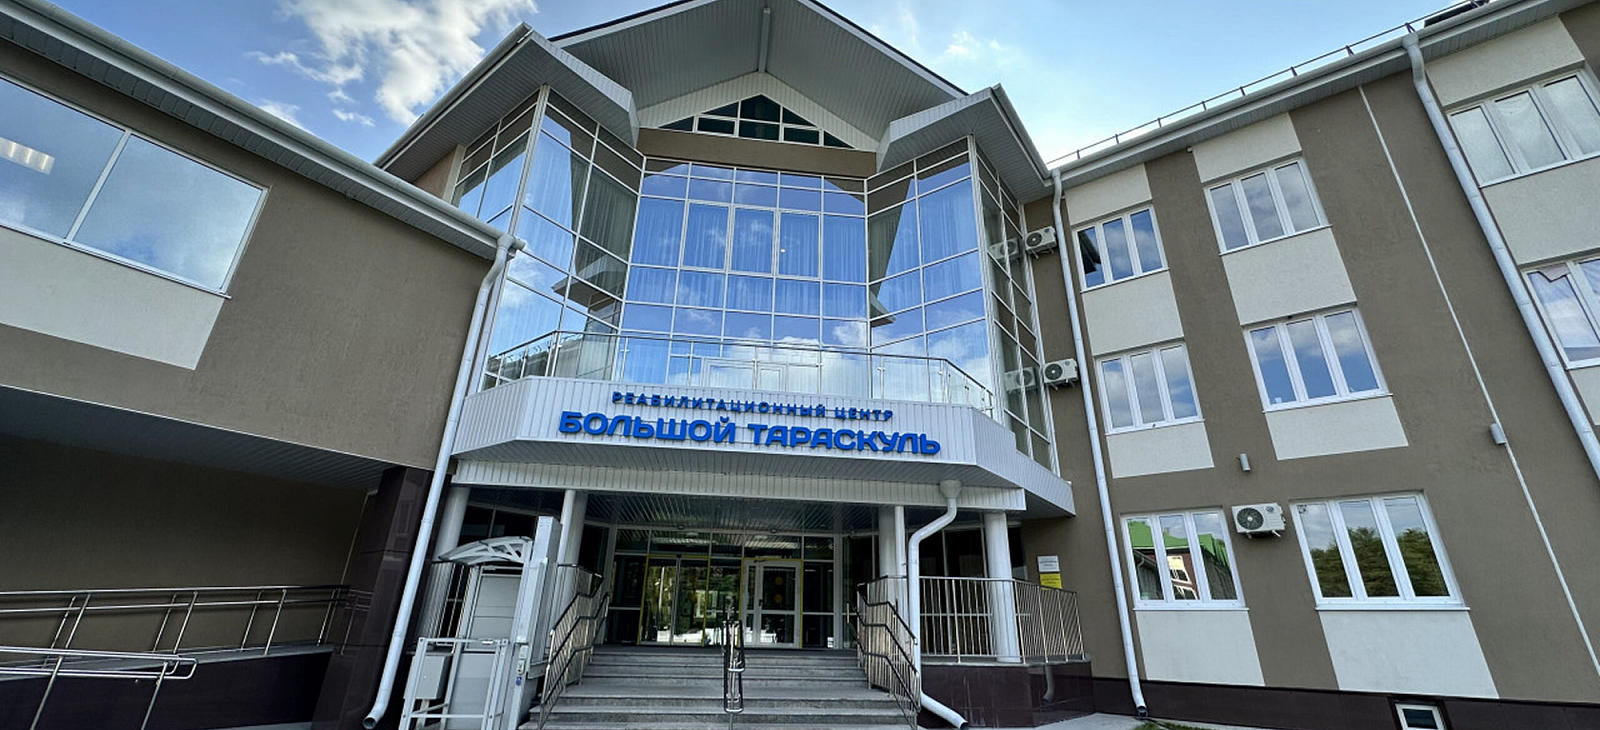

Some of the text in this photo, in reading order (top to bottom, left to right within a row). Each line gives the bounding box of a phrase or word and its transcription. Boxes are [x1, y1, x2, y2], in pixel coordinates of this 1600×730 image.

[612, 392, 894, 421] РЕАБИЛИТАЦИОННЫЙ ЦЕНТР
[559, 411, 941, 455] БОЛЬШОЙ ТАРАСКУЛЬ
